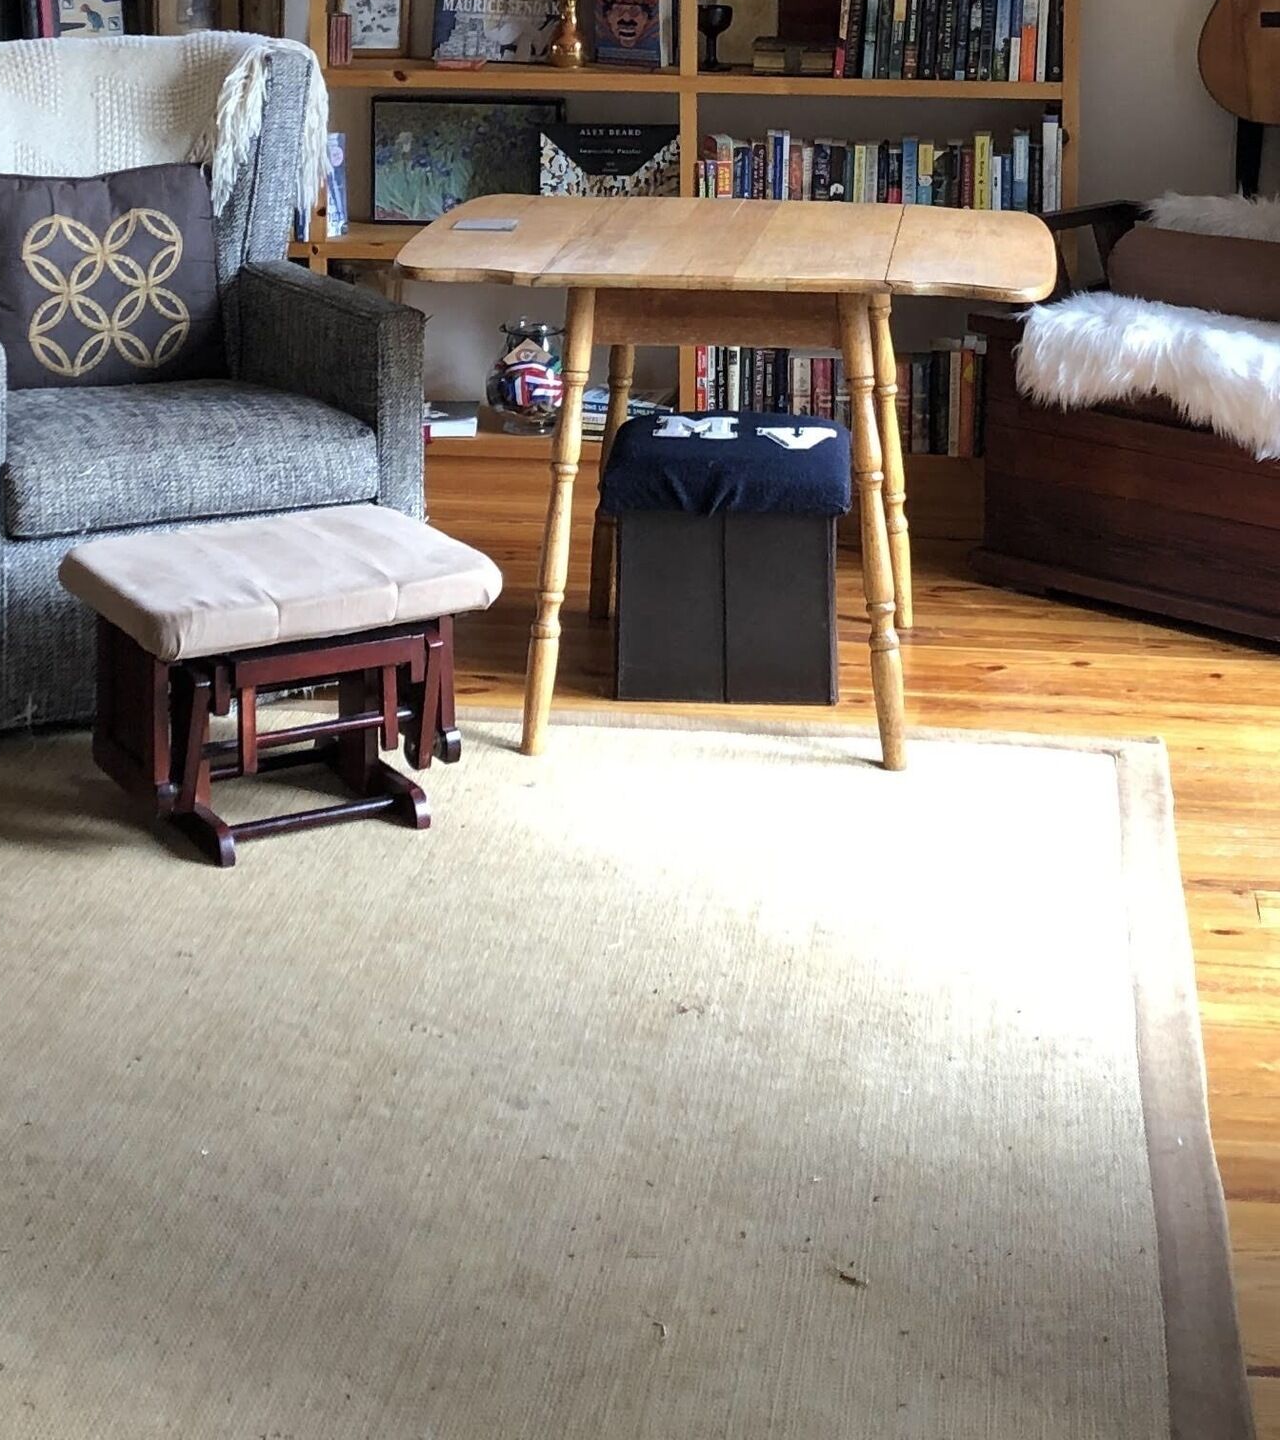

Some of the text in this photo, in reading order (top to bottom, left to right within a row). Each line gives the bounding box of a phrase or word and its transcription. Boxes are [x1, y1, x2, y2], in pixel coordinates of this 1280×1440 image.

[579, 128, 642, 137] ALEX BEARD
[754, 350, 763, 396] PART WILD
[652, 415, 739, 440] M
